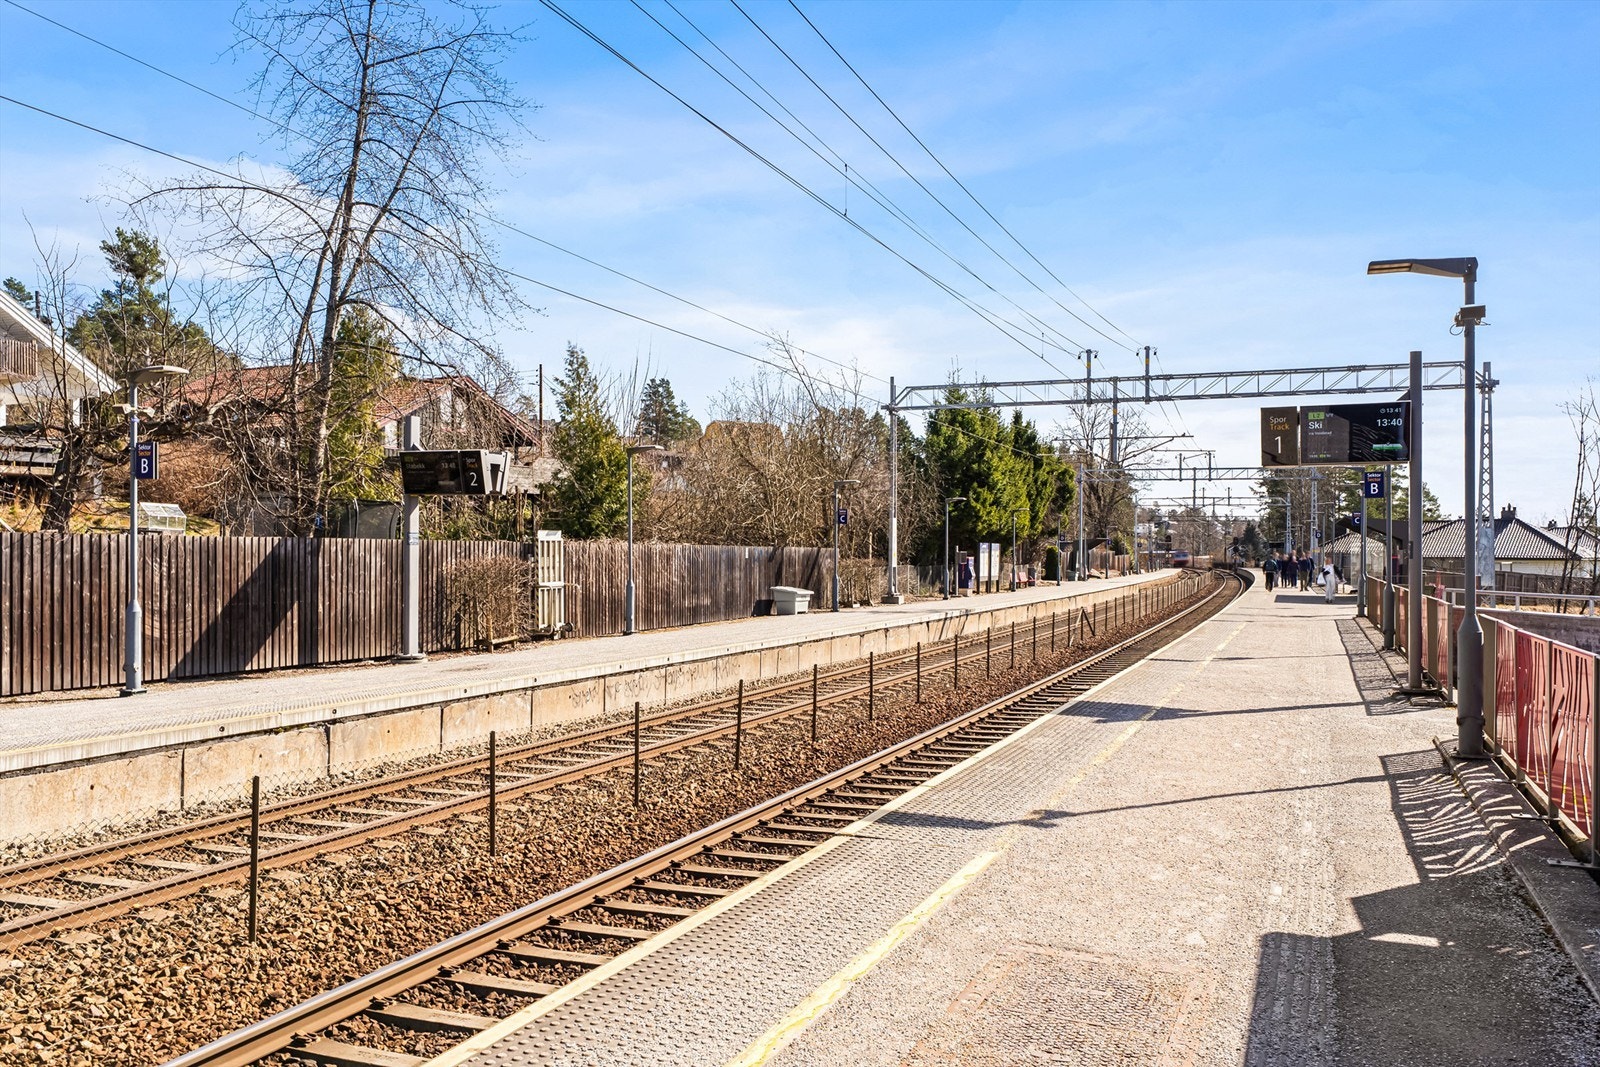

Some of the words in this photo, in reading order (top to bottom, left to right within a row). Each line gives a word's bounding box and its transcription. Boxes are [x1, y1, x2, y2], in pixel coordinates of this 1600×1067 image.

[1269, 416, 1287, 424] Spor
[1308, 421, 1323, 429] Ski
[1376, 418, 1403, 427] 13:40
[1270, 423, 1290, 431] Track
[1274, 435, 1282, 454] 1
[141, 458, 149, 474] B
[469, 471, 478, 486] 2
[1370, 482, 1379, 495] B
[1354, 516, 1360, 524] C
